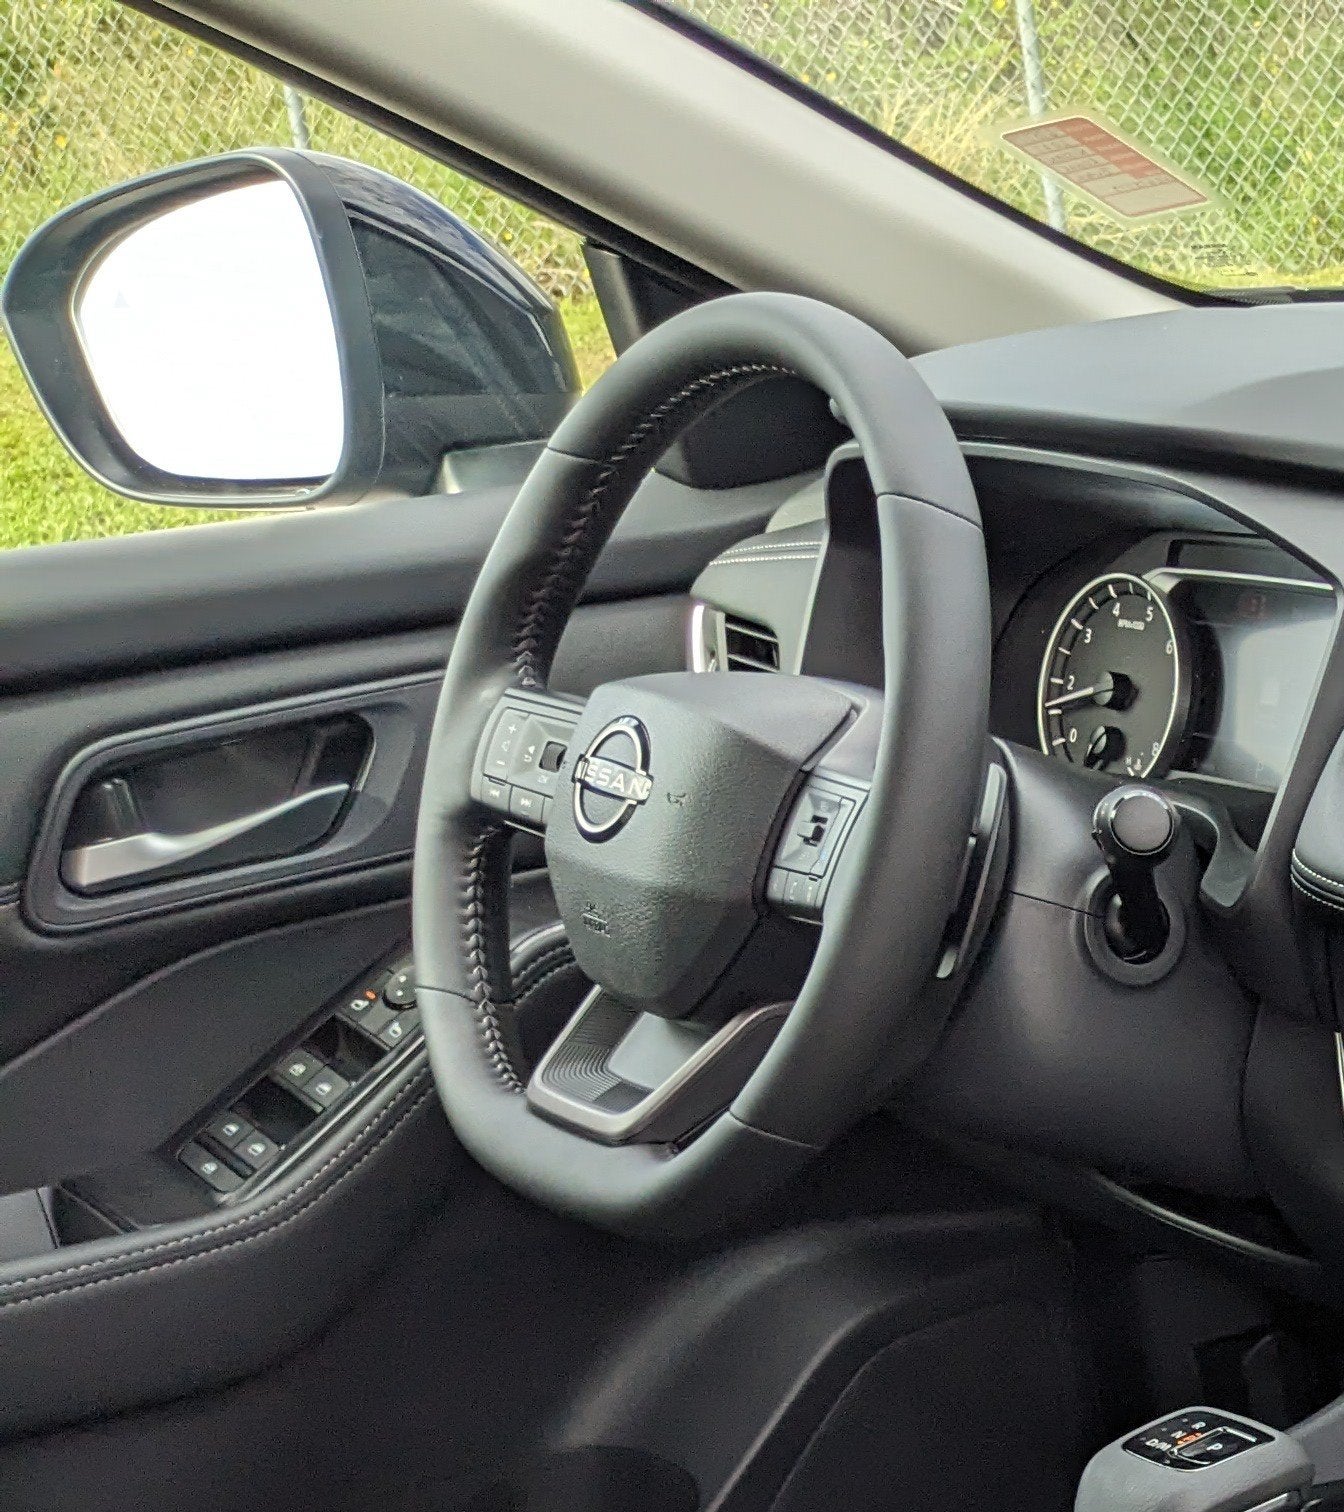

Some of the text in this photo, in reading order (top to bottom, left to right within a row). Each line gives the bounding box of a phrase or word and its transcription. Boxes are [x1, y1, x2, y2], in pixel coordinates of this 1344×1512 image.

[1112, 602, 1120, 616] 4
[1146, 606, 1153, 622] 5
[1084, 628, 1092, 644] 3
[1166, 640, 1173, 654] 6
[1067, 675, 1074, 690] 2
[1070, 728, 1077, 742] 0
[575, 760, 652, 800] NISSAN
[1206, 1442, 1223, 1451] P
